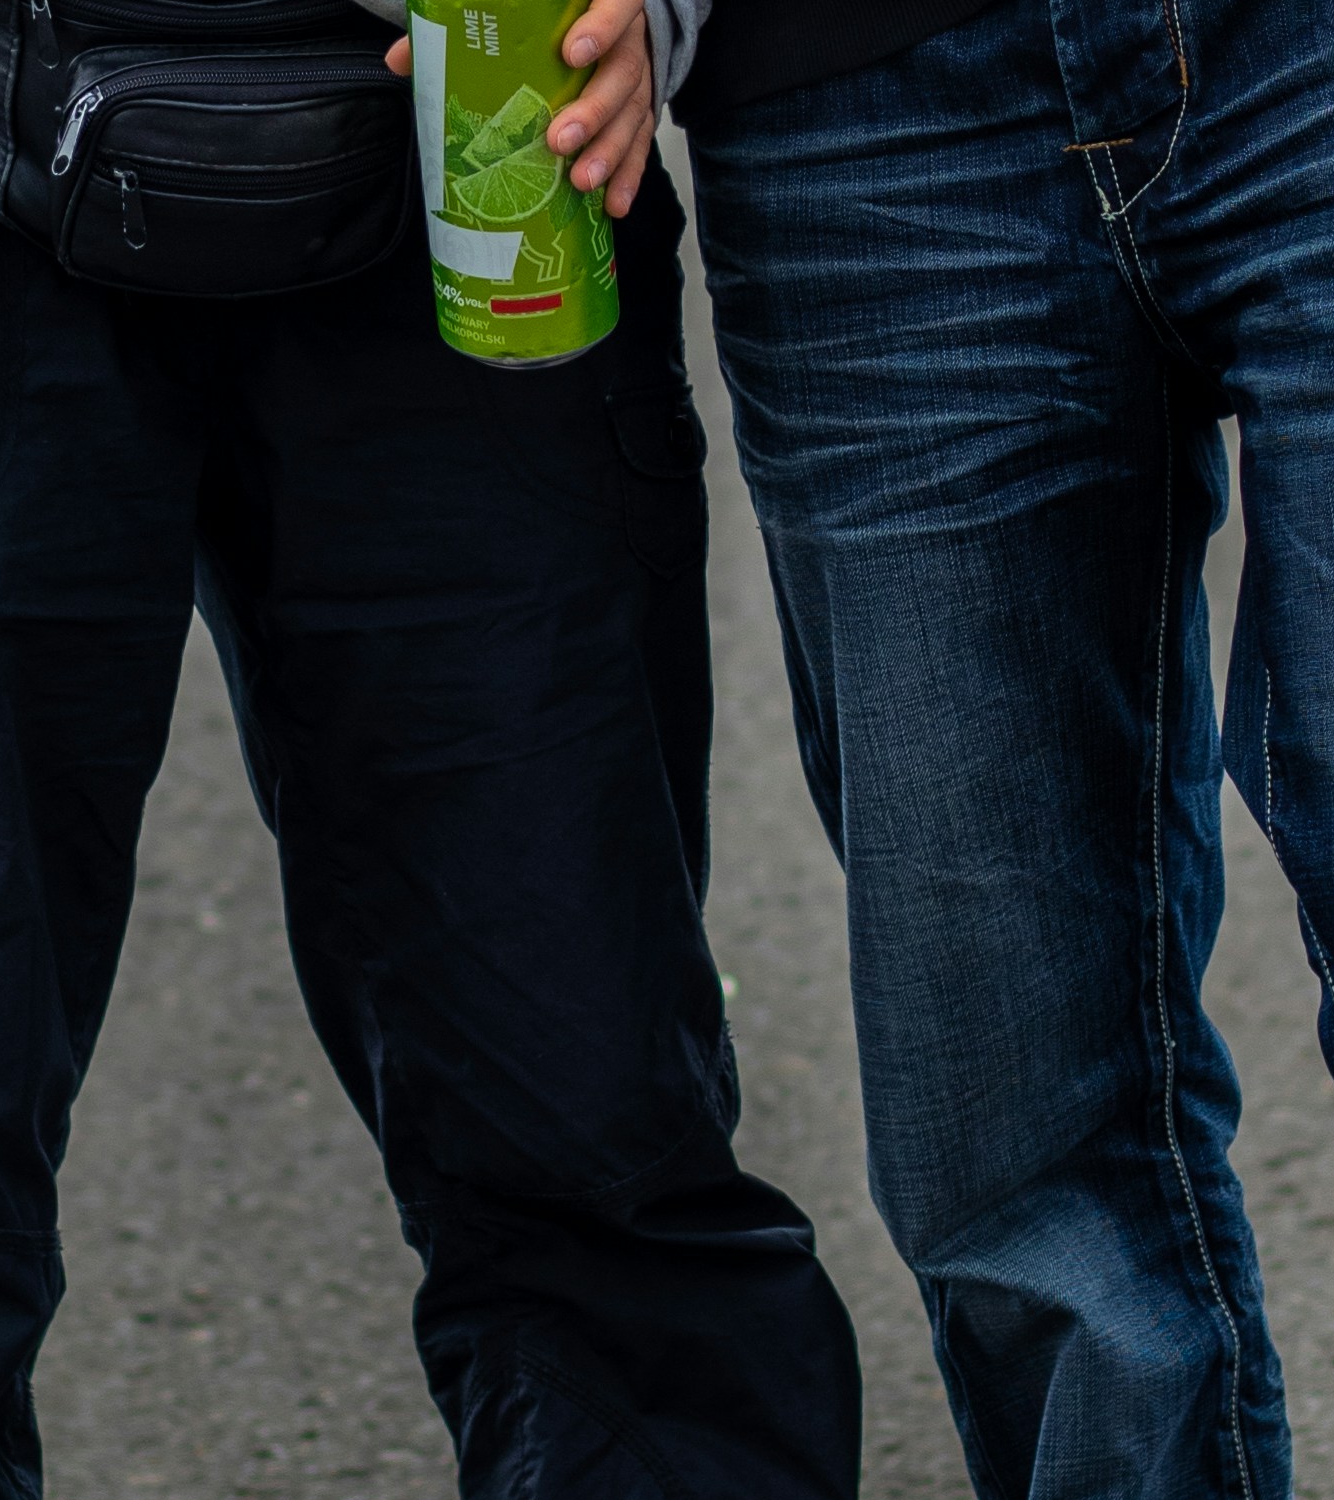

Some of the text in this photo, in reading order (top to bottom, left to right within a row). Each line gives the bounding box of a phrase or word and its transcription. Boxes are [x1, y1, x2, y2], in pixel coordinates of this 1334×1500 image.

[464, 8, 481, 50] LIME
[482, 11, 501, 57] MINT
[443, 284, 465, 307] 4%
[444, 306, 490, 330] BROWARY
